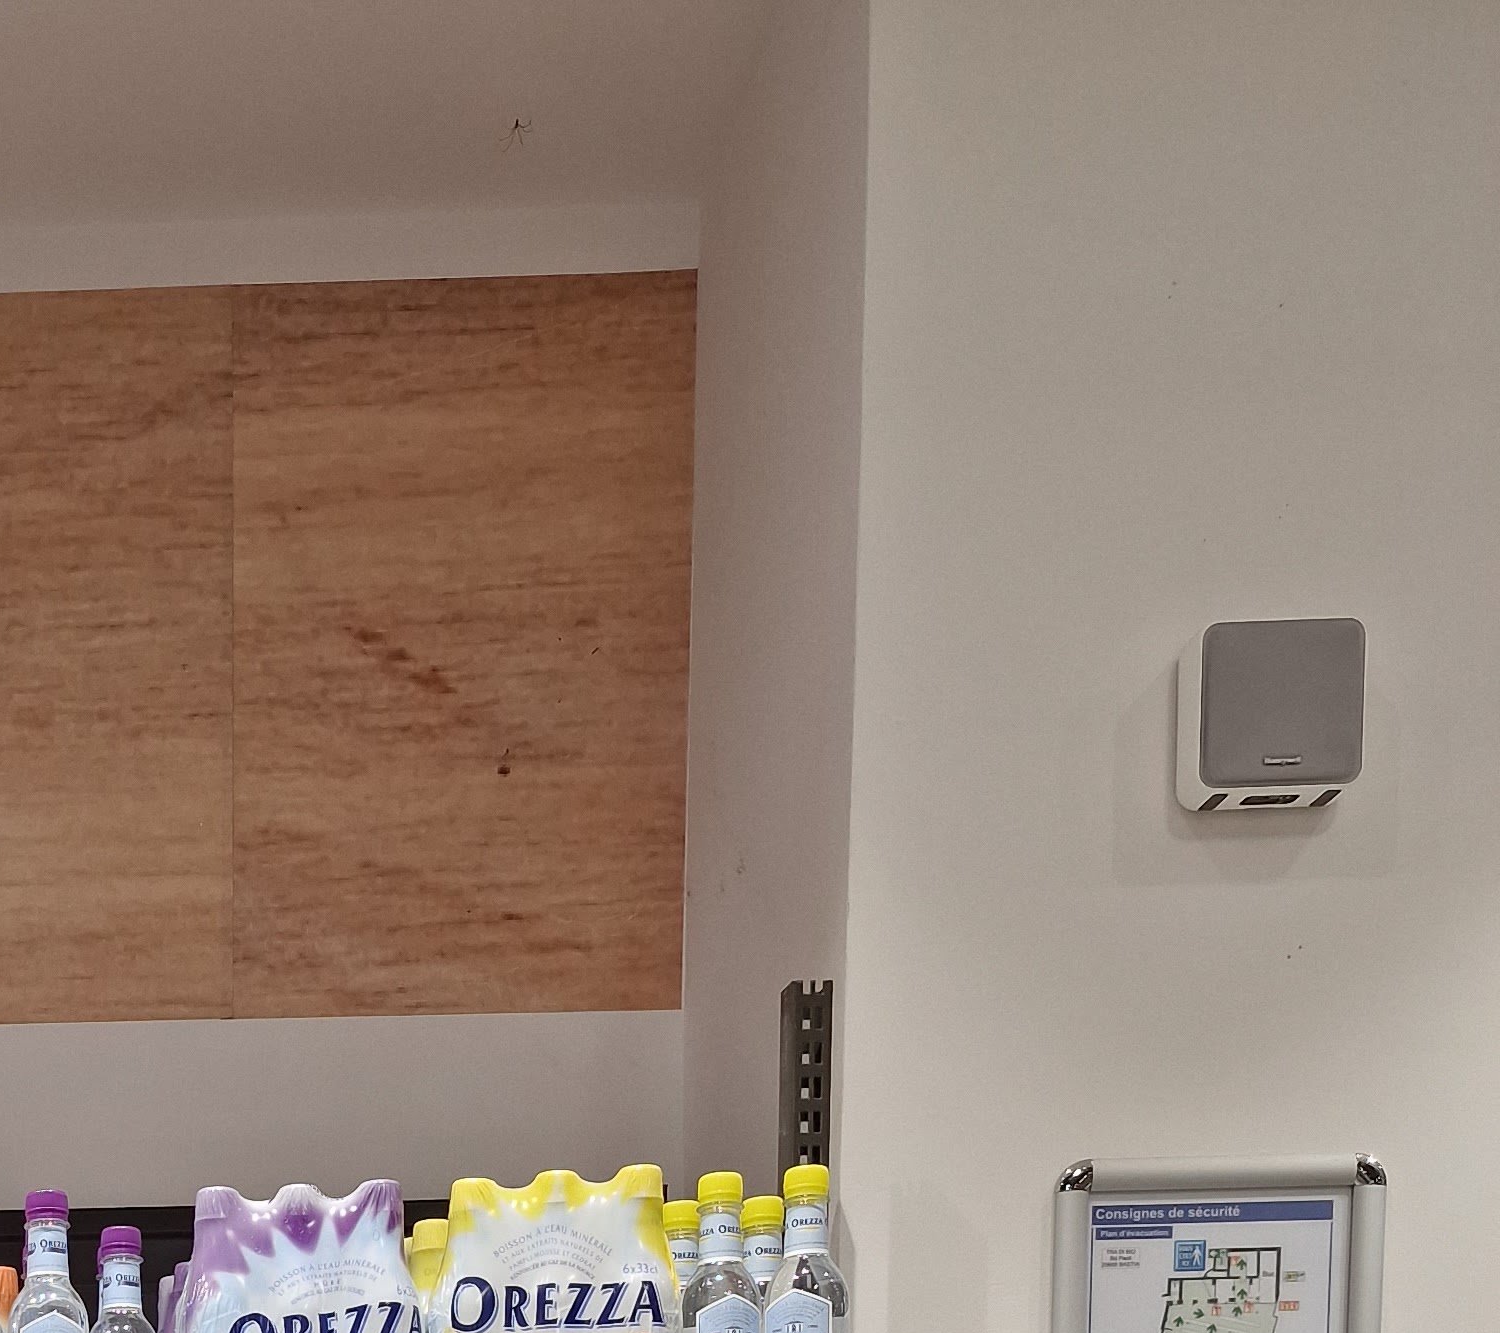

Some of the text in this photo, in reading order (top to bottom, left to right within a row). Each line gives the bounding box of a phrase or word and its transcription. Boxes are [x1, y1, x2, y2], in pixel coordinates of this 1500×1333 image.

[1096, 1204, 1241, 1222] Consignes de sécurité
[493, 1233, 533, 1257] BOISSON
[570, 1228, 613, 1257] MINÉRALE
